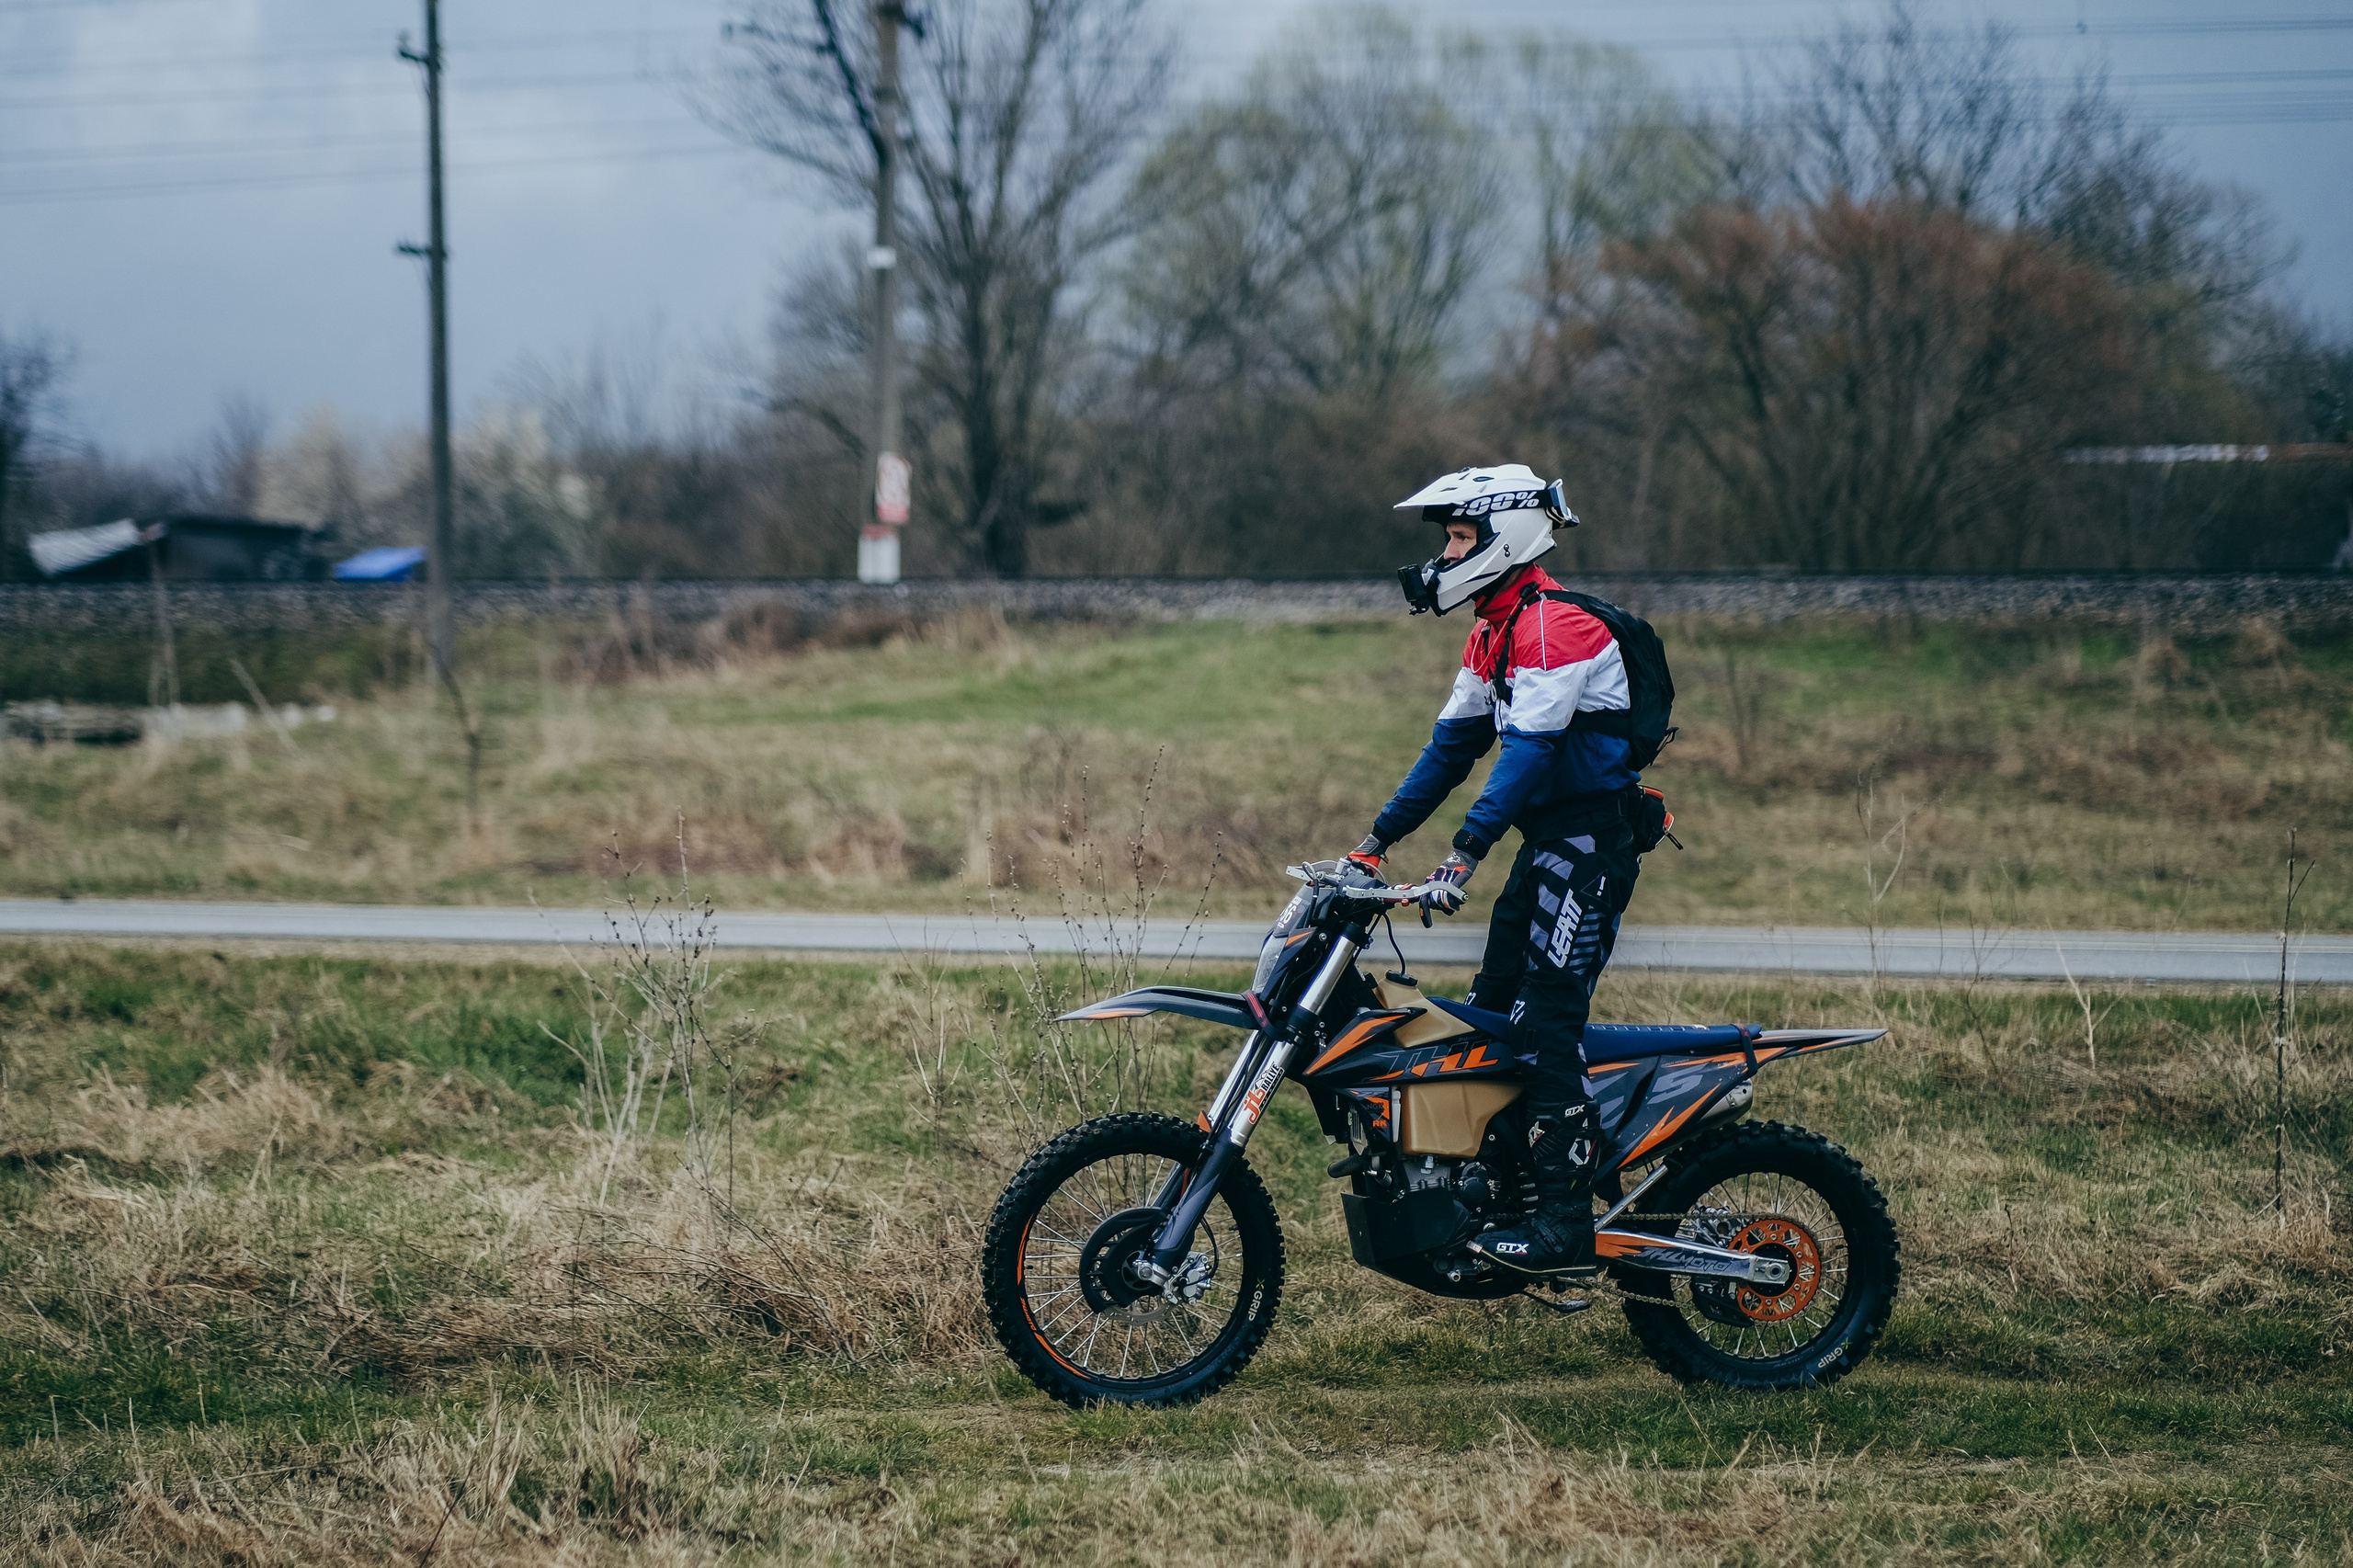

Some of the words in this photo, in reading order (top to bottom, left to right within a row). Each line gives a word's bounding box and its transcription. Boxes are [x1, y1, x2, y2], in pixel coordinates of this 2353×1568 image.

[1547, 888, 1582, 969] LEATT
[1261, 1063, 1281, 1092] RALLYE
[1564, 1104, 1586, 1118] GTX
[1495, 1242, 1529, 1255] GTX
